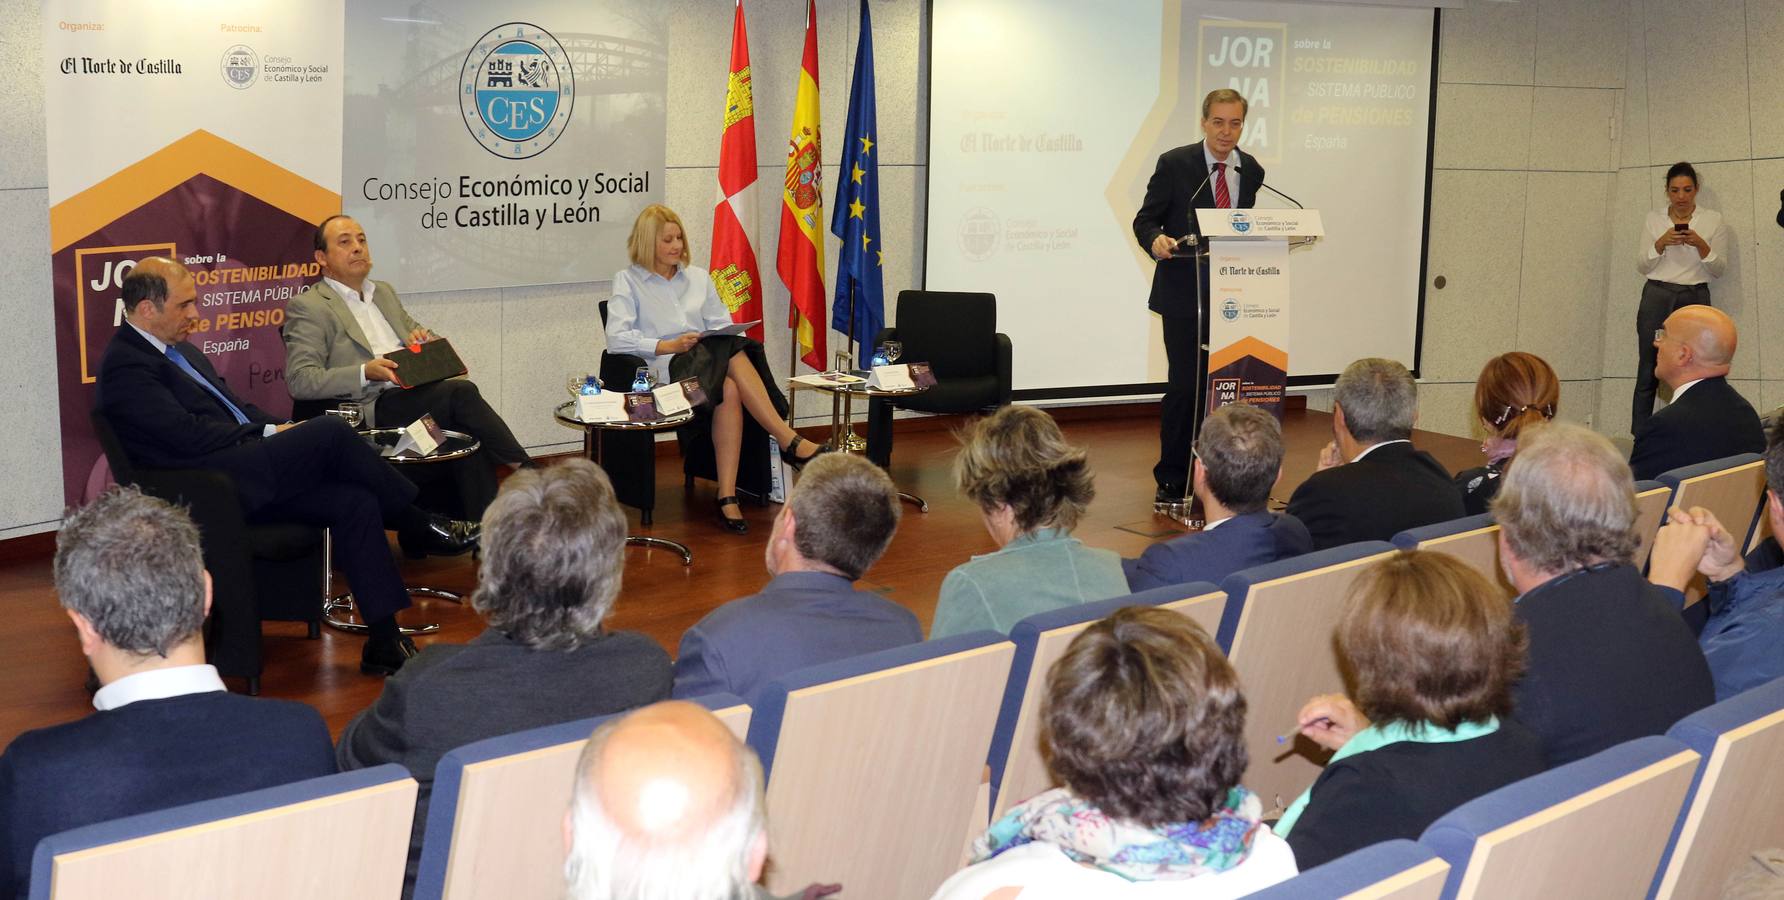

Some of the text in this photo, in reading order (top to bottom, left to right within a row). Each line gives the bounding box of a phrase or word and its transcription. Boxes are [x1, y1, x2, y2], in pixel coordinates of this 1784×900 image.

[59, 21, 104, 32] Organiza:
[220, 24, 263, 33] Patrocina:
[1208, 36, 1274, 68] JOR
[1294, 38, 1331, 49] sobre la
[60, 57, 182, 75] El Norte de Castilla
[264, 54, 292, 65] Consejo
[264, 64, 302, 73] Económico
[308, 65, 328, 73] Social
[1293, 57, 1417, 75] SOSTENIBILIDAD
[264, 74, 272, 82] de
[274, 74, 299, 82] Castilla
[305, 74, 322, 82] León
[1307, 81, 1361, 97] SISTEMA
[487, 96, 545, 130] CES
[1316, 106, 1413, 126] PENSIONES
[363, 171, 649, 205] Consejo Económico y Social
[421, 201, 600, 230] de Castilla y León
[184, 253, 226, 266] sobre la
[91, 260, 137, 291] JO
[1229, 266, 1247, 275] Norte
[1256, 266, 1280, 275] Castilla
[202, 285, 311, 307] SISTEMA PÚBLIC
[215, 308, 285, 331] PENSIO
[202, 338, 250, 356] España
[249, 362, 284, 391] Pen
[1216, 382, 1236, 391] JOR
[1221, 391, 1235, 400] NA
